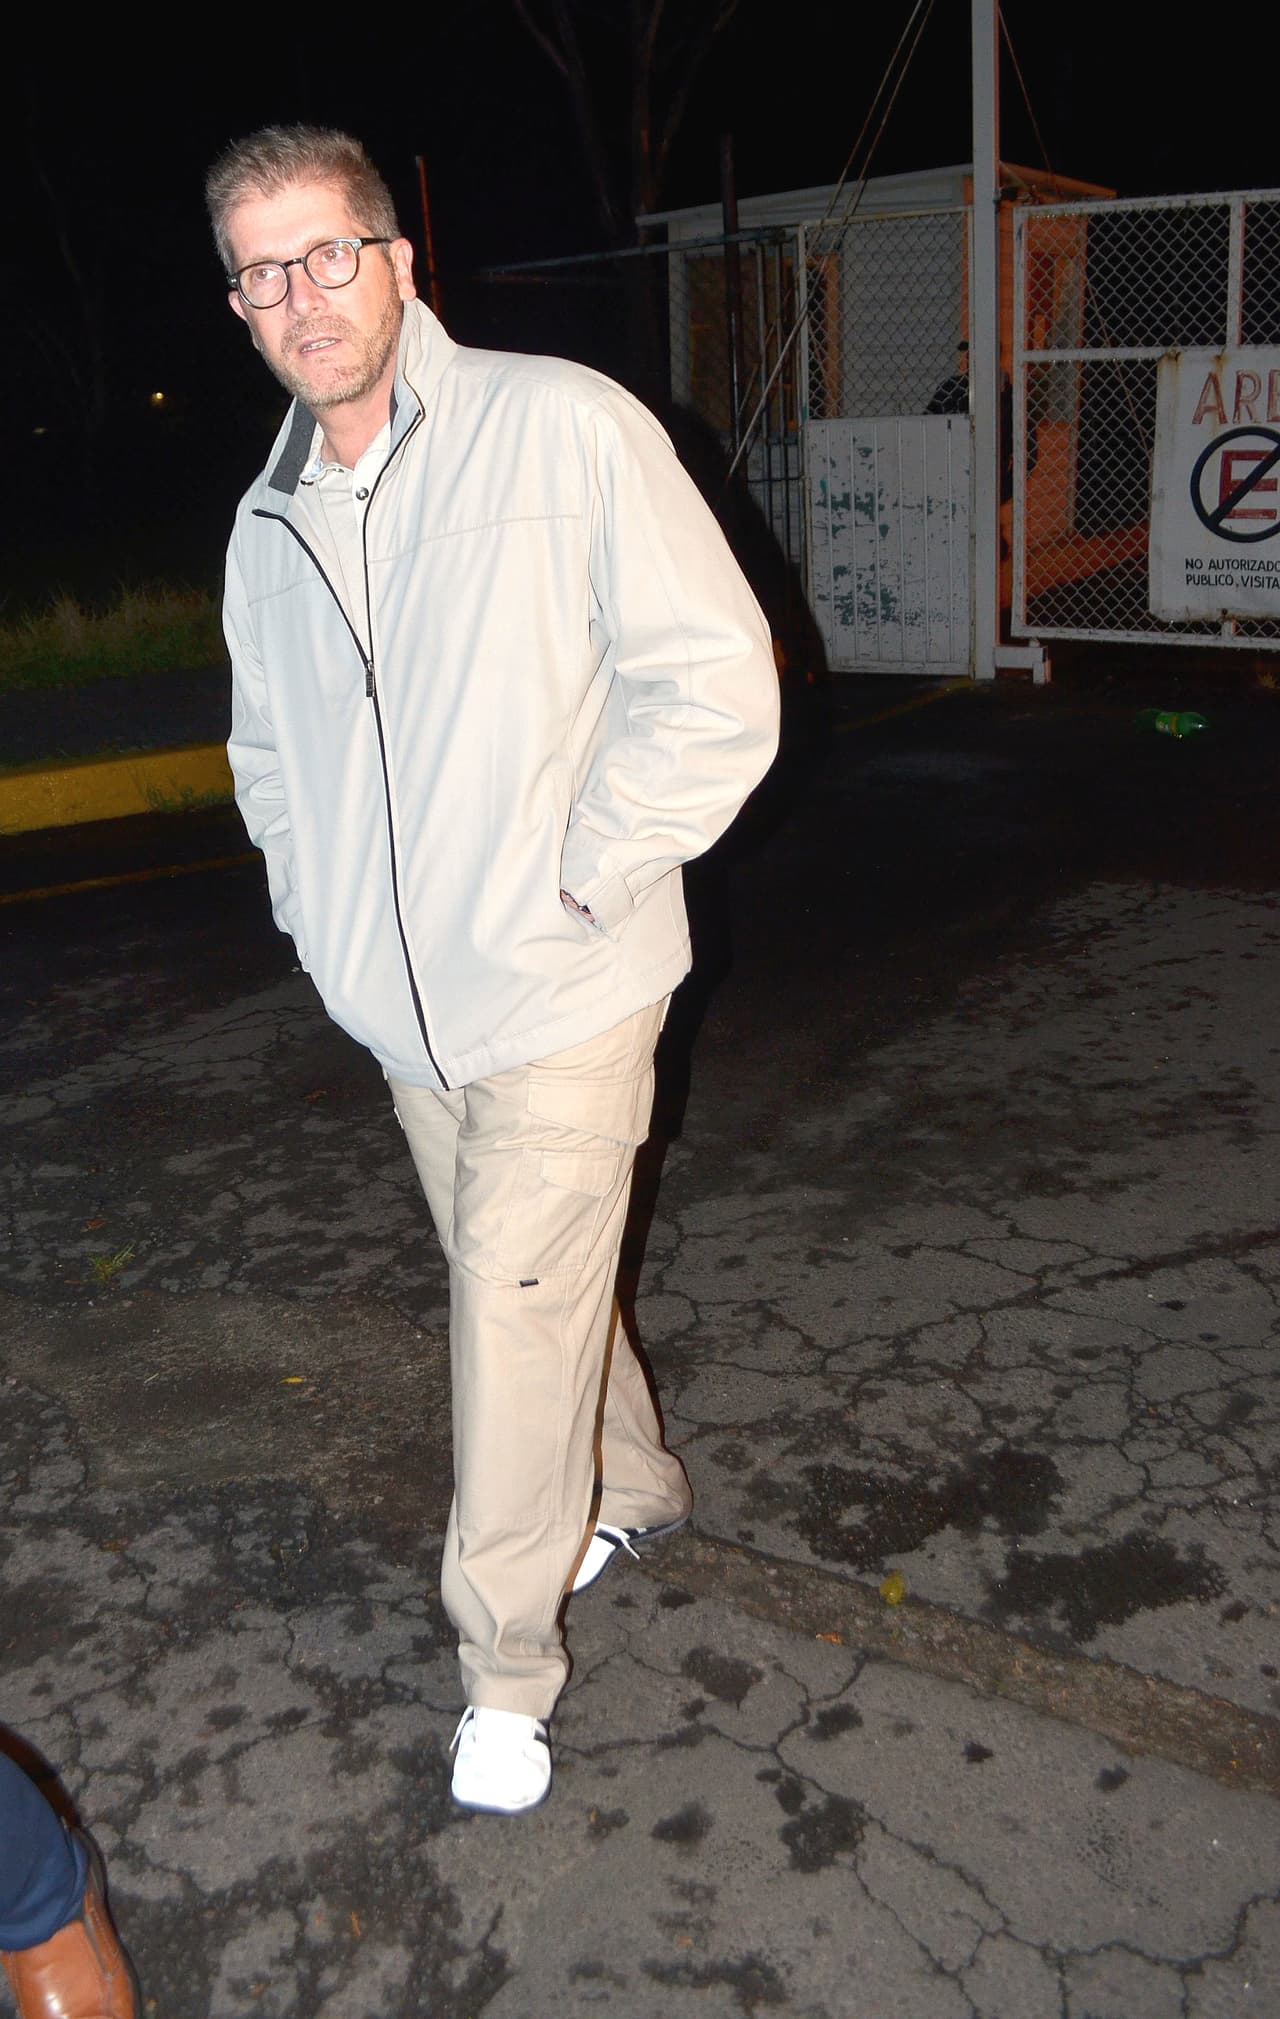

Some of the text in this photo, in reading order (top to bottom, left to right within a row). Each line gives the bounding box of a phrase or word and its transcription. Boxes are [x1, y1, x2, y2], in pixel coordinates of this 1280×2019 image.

[1219, 450, 1278, 520] E
[1185, 558, 1203, 570] NO
[1241, 575, 1280, 590] VISITA
